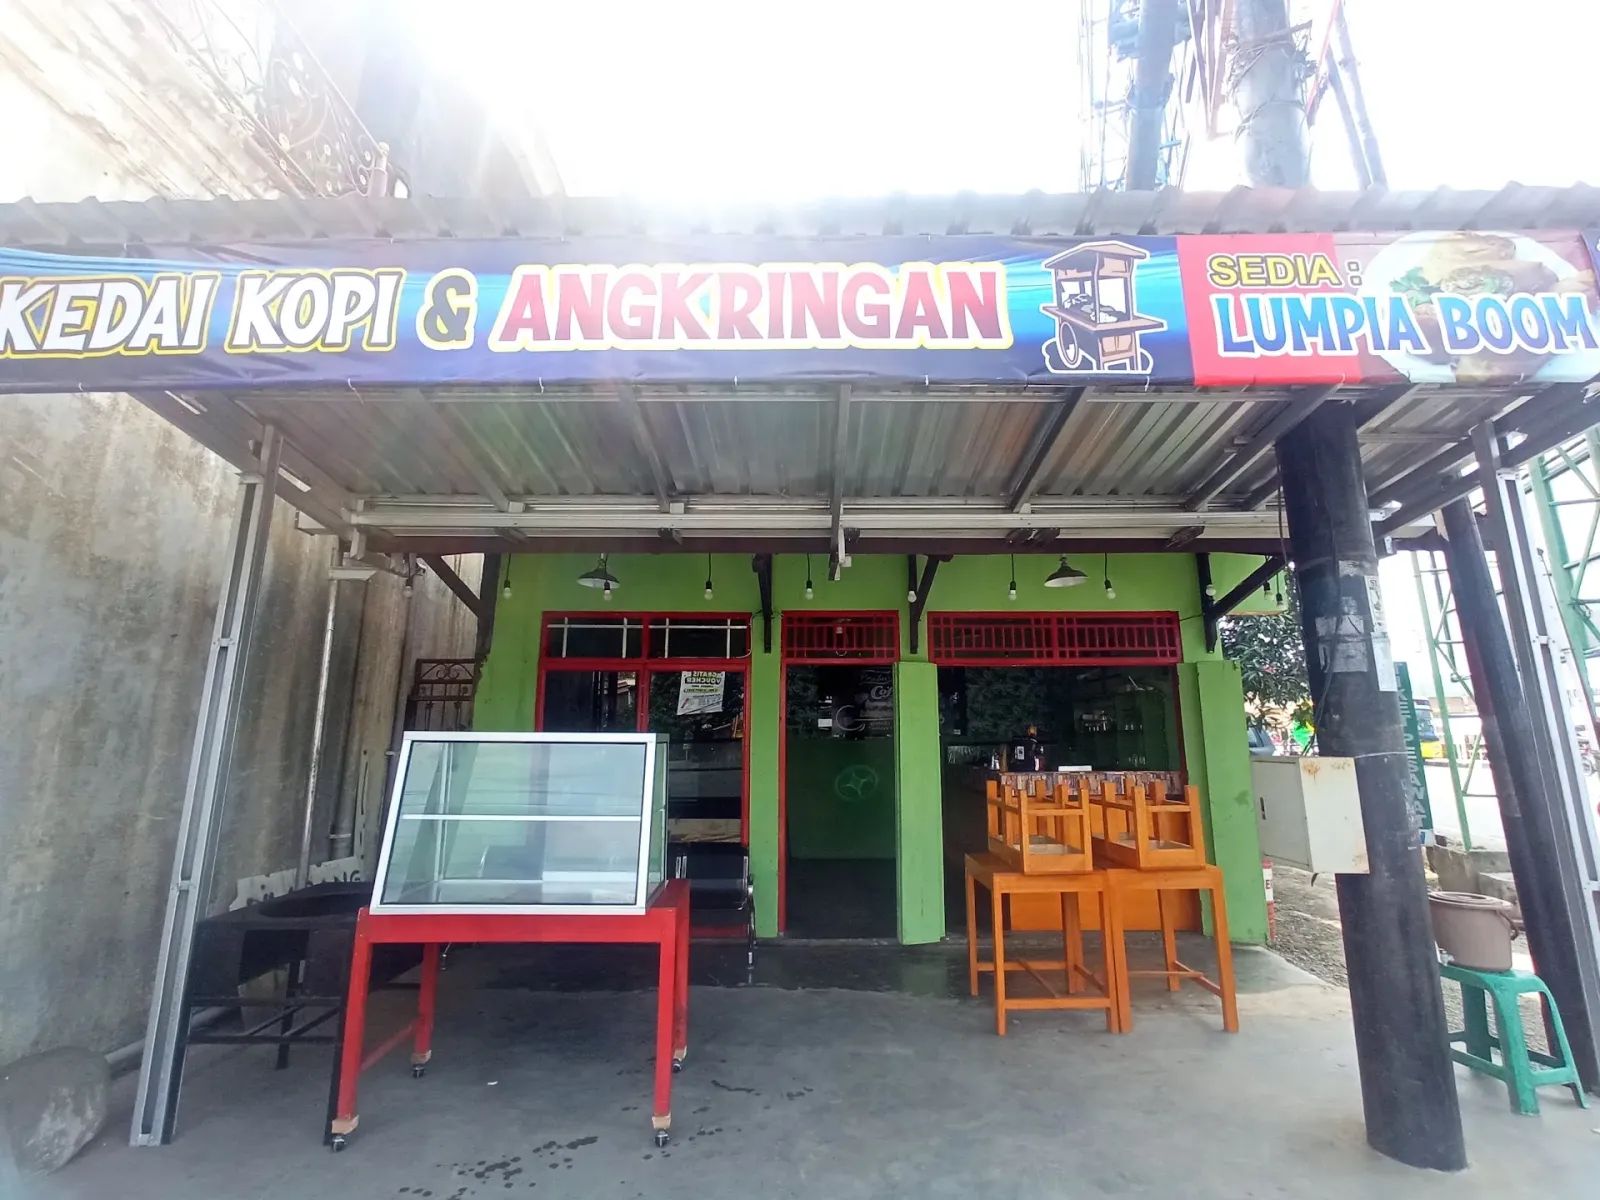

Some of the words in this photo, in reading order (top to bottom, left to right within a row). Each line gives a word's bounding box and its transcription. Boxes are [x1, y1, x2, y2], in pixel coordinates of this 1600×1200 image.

[1208, 254, 1343, 287] SEDIA
[0, 271, 213, 353] KEDAI
[227, 271, 402, 350] KOPI
[420, 271, 474, 346] &
[495, 268, 1008, 345] ANGKRINGAN
[1211, 293, 1430, 355] LUMPIA
[1441, 293, 1600, 355] BOOM
